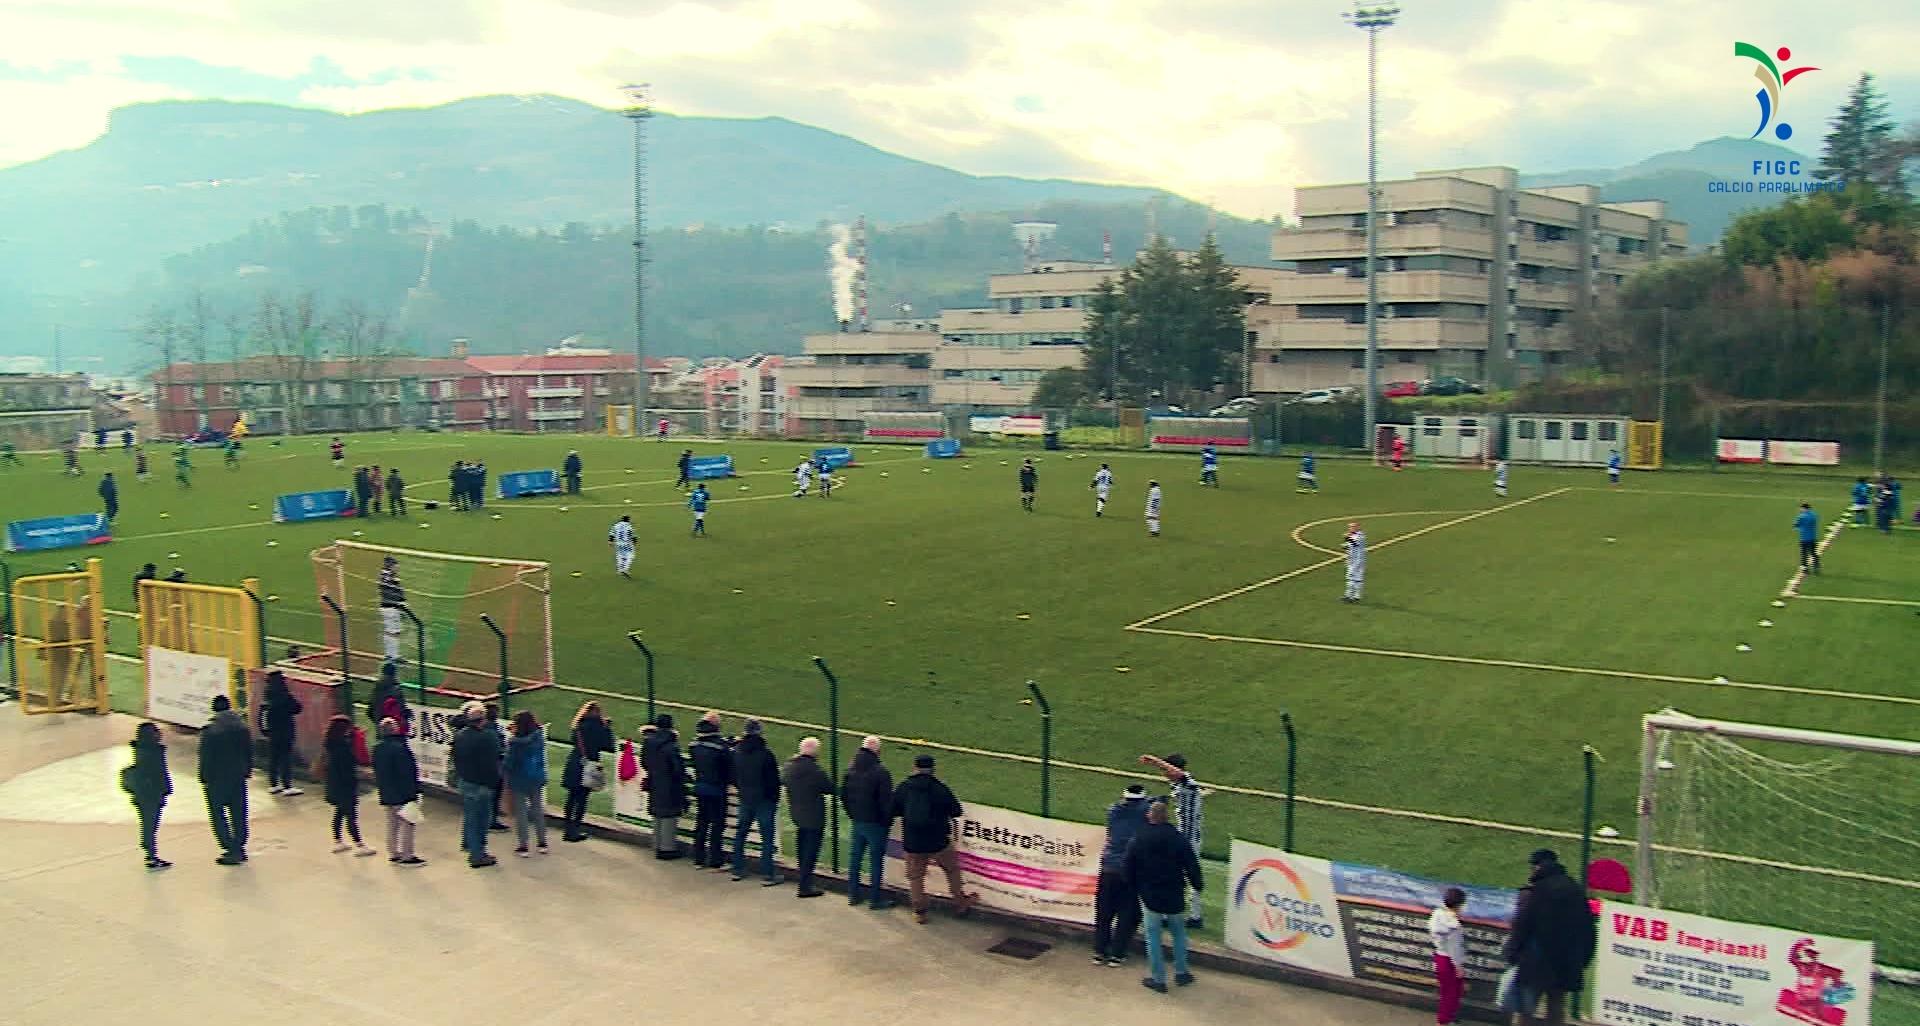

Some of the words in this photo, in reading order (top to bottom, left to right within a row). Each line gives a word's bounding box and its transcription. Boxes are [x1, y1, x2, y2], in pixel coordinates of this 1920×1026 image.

[963, 820, 1085, 856] ElettroPaint
[1613, 913, 1668, 941] VAB
[1677, 931, 1768, 959] Impianti
